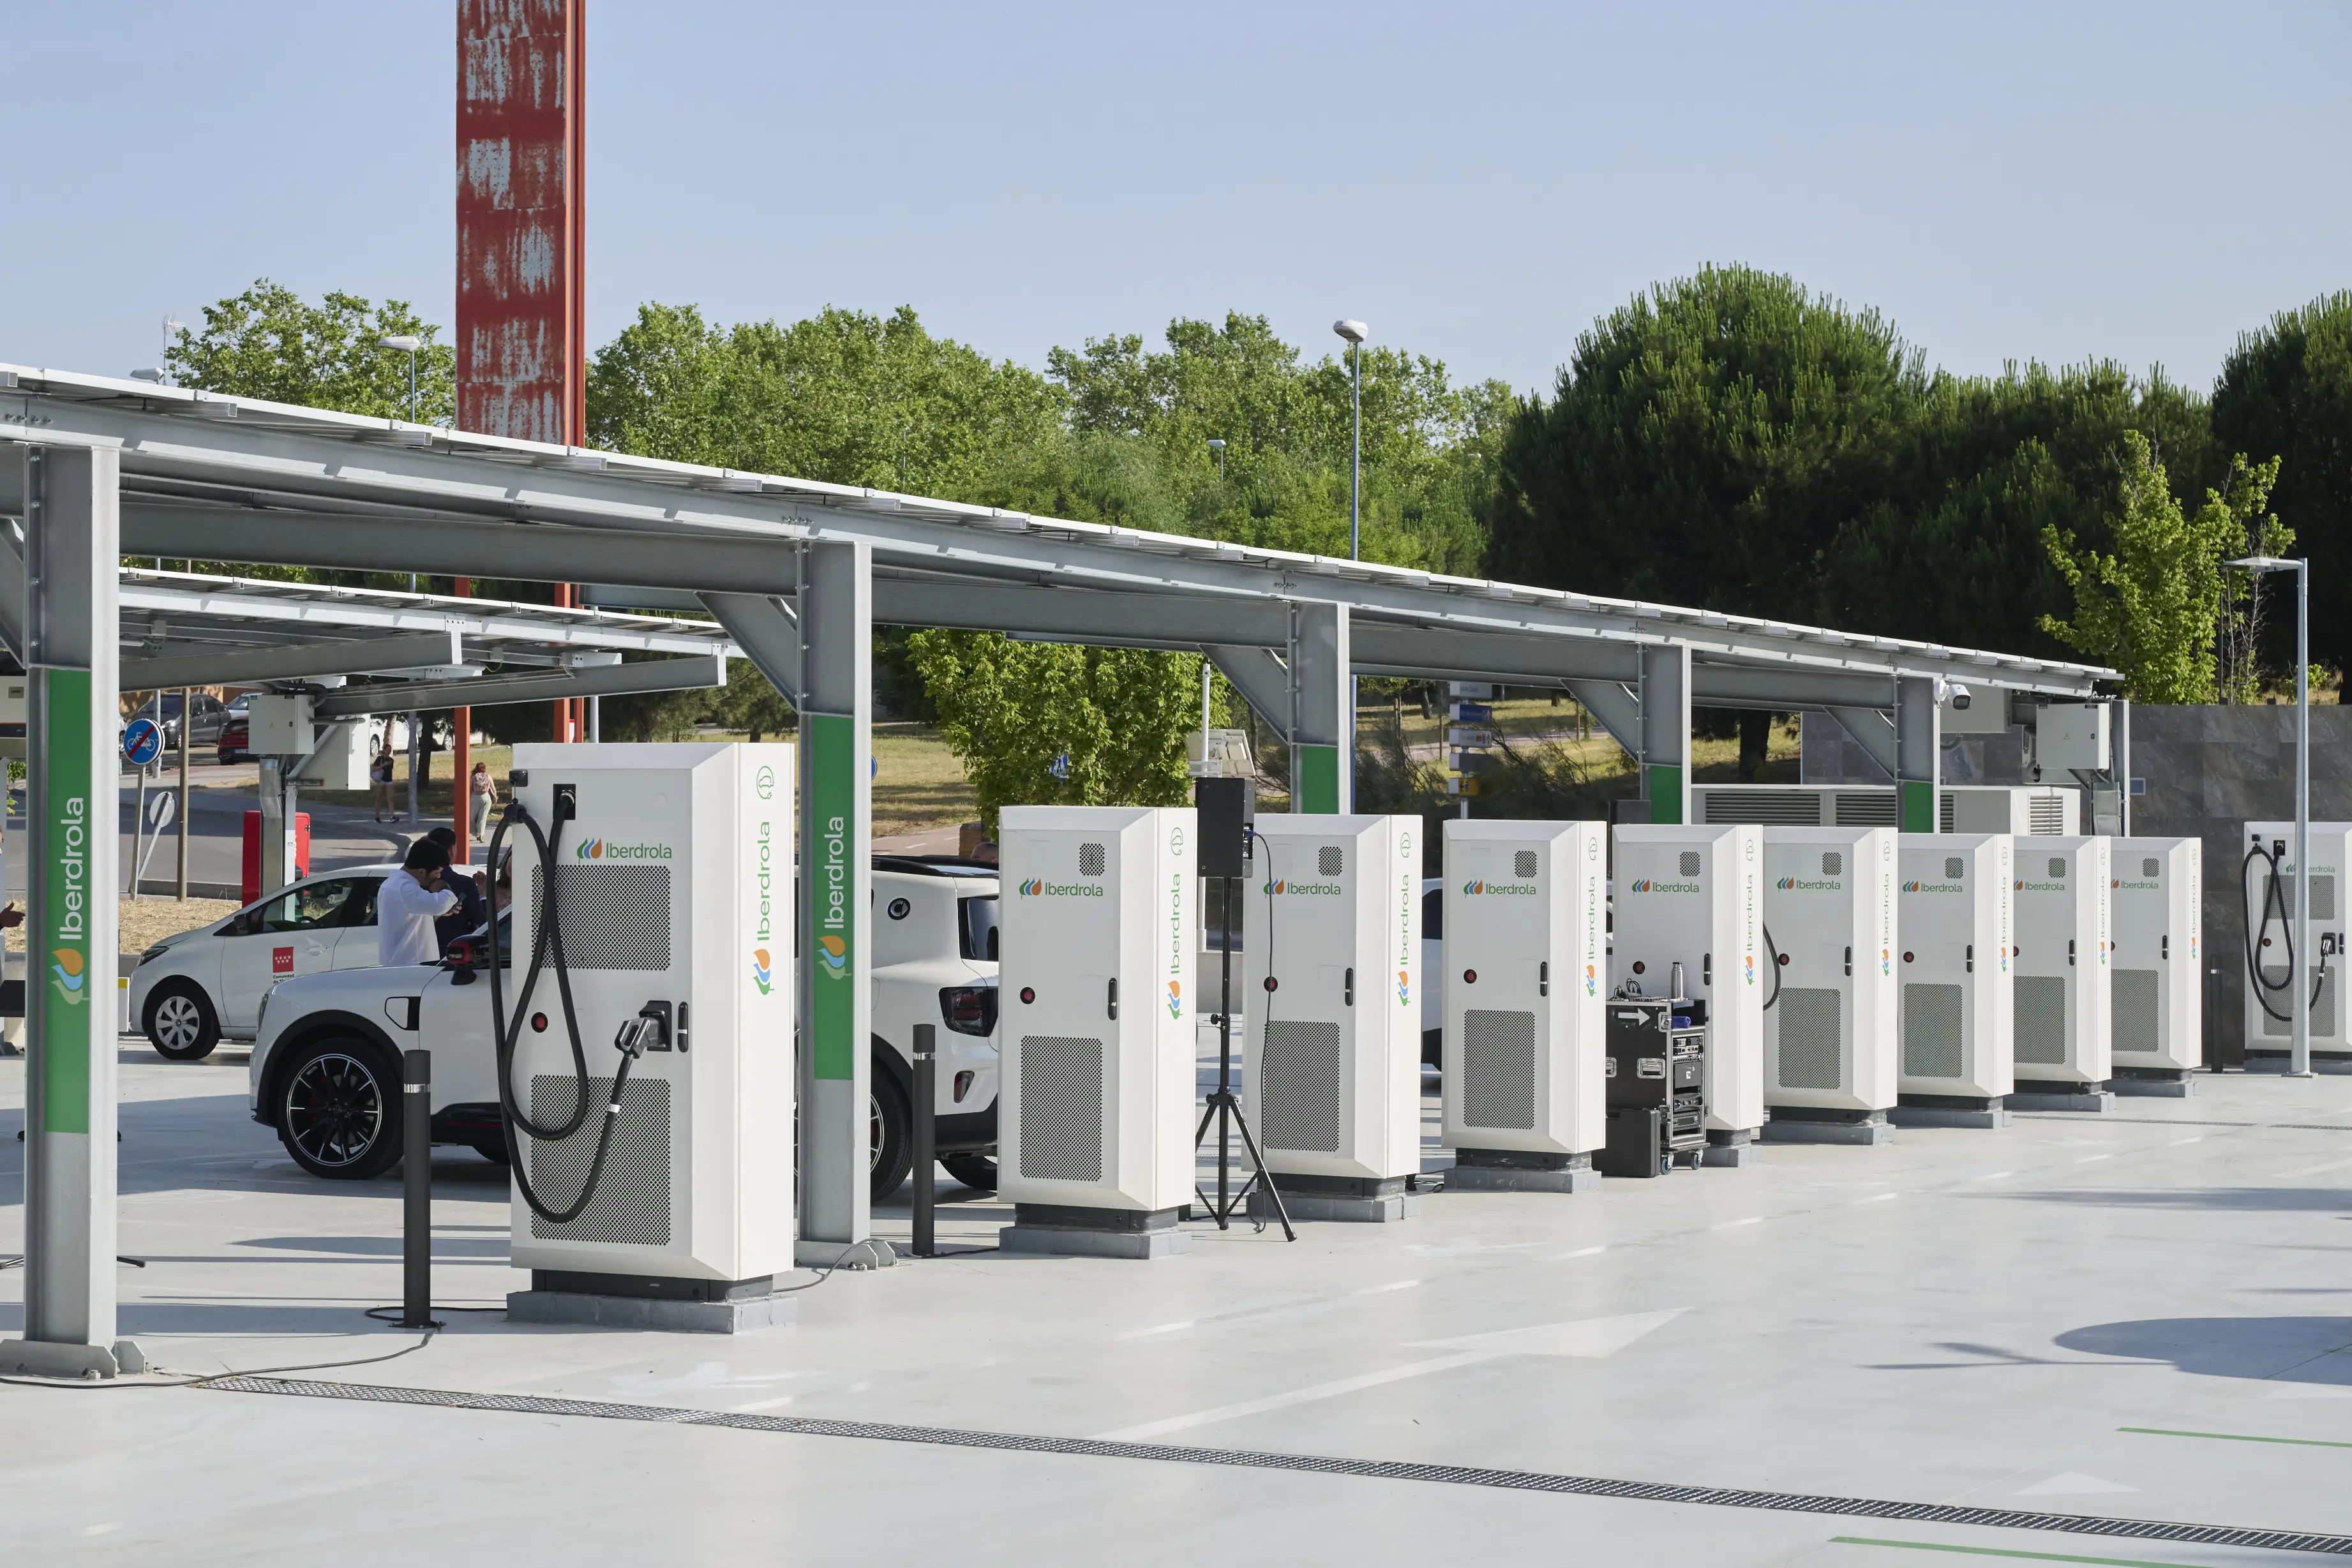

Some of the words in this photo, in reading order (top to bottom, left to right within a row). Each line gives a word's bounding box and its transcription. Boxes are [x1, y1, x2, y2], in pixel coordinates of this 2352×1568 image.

[606, 843, 671, 858] Iberdrola
[59, 798, 83, 939] Iberdrola
[825, 818, 844, 928] Iberdrola
[758, 822, 770, 941] Iberdrola
[1653, 882, 1699, 892] Iberdrola
[1797, 880, 1840, 889] Iberdrola
[1921, 883, 1962, 892] Iberdrola
[2025, 881, 2064, 890] Iberdrola
[1045, 883, 1103, 896] Iberdrola
[1288, 883, 1340, 895] Iberdrola
[1487, 883, 1536, 894] Iberdrola
[1171, 874, 1180, 974] Iberdrola
